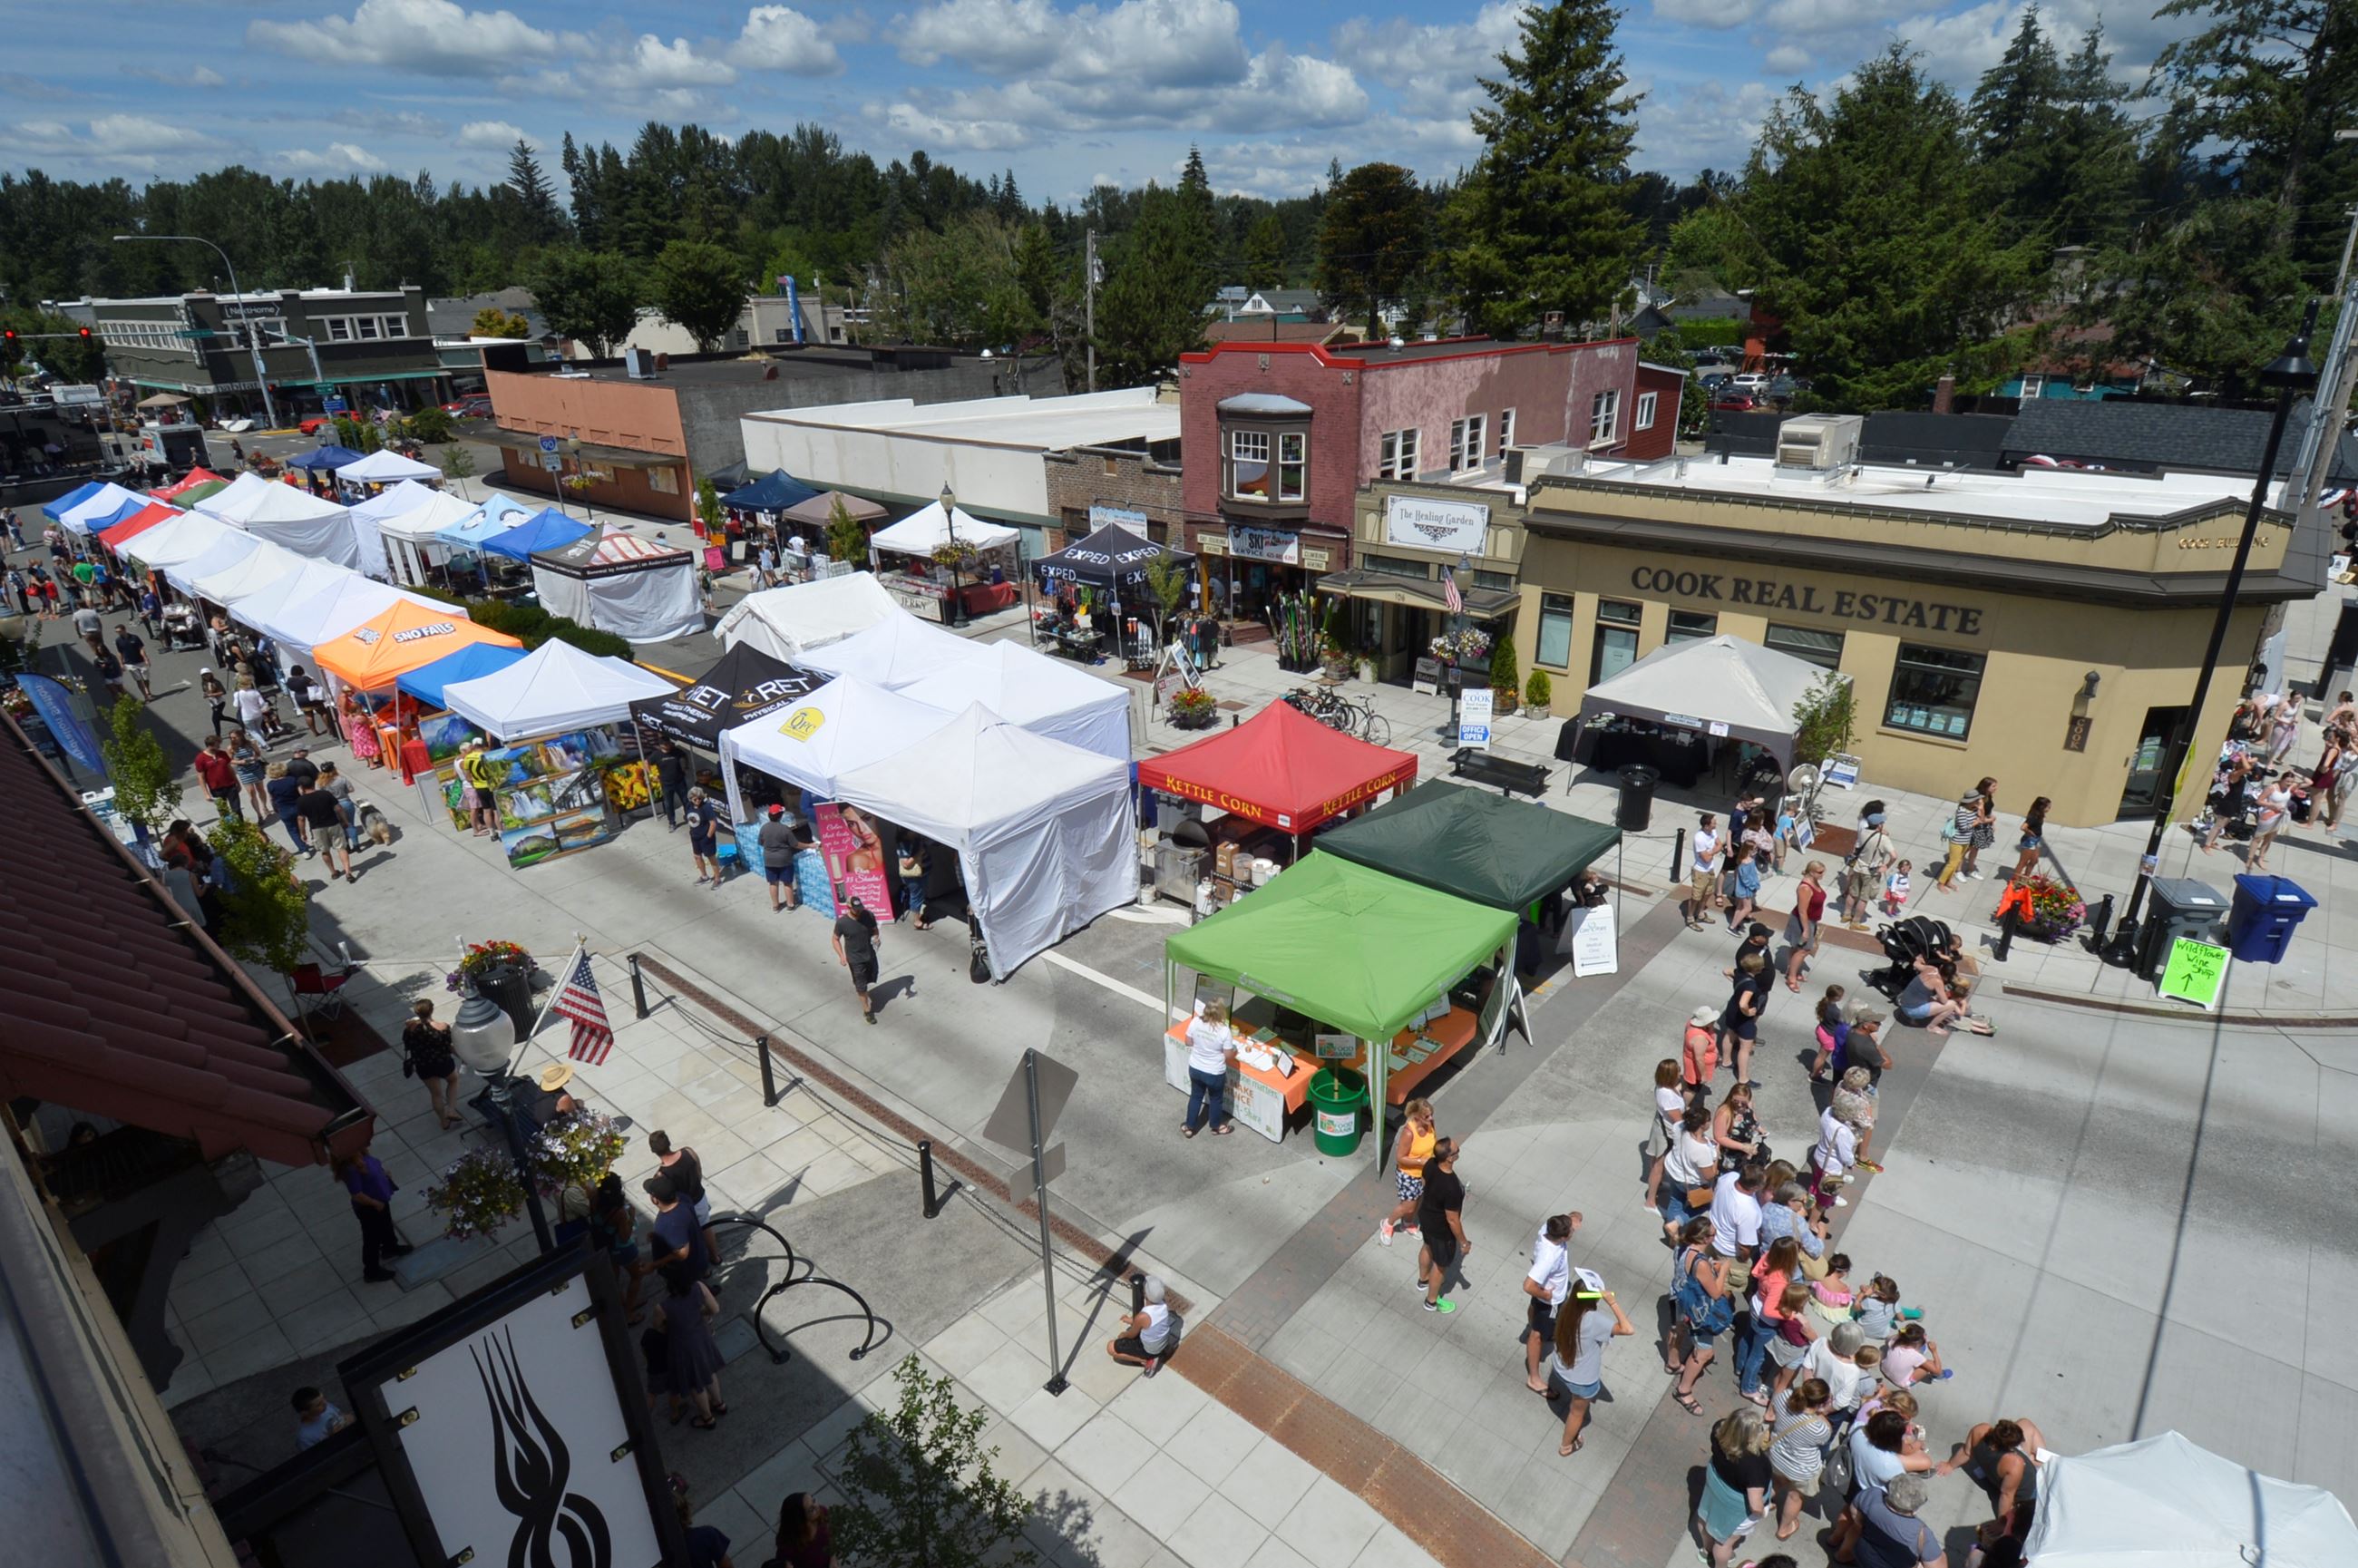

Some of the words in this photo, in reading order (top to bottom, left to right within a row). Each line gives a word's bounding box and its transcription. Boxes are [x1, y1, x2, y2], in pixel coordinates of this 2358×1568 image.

[542, 441, 554, 449] 90
[1400, 508, 1412, 520] The
[1415, 510, 1444, 523] Healing
[1446, 513, 1475, 526] Garden
[1249, 533, 1263, 550] SKI
[2178, 538, 2210, 550] COOK
[2216, 536, 2269, 550] BUILNG
[1064, 549, 1111, 565] EXPED
[1115, 546, 1160, 564] EXPED
[1040, 565, 1077, 582] EXPED
[1631, 566, 1723, 600] COOK
[1730, 578, 1825, 614] REAL
[1831, 590, 1983, 636] ESTATE
[394, 629, 423, 643] SNO
[755, 677, 814, 701] RET
[1463, 695, 1491, 703] COOK
[742, 699, 792, 721] PHYSICAL
[790, 715, 814, 734] QFC
[1462, 726, 1486, 734] OFFICE
[1463, 733, 1483, 741] OPEN
[2070, 718, 2086, 750] COOK
[1165, 774, 1213, 802] KETTLE
[1220, 794, 1262, 819] CORN
[1322, 788, 1362, 816] KETTLE
[1366, 771, 1398, 793] CORN
[2176, 940, 2226, 961] Wildflower
[2187, 953, 2209, 968] Wine
[1335, 1120, 1353, 1128] FOOD
